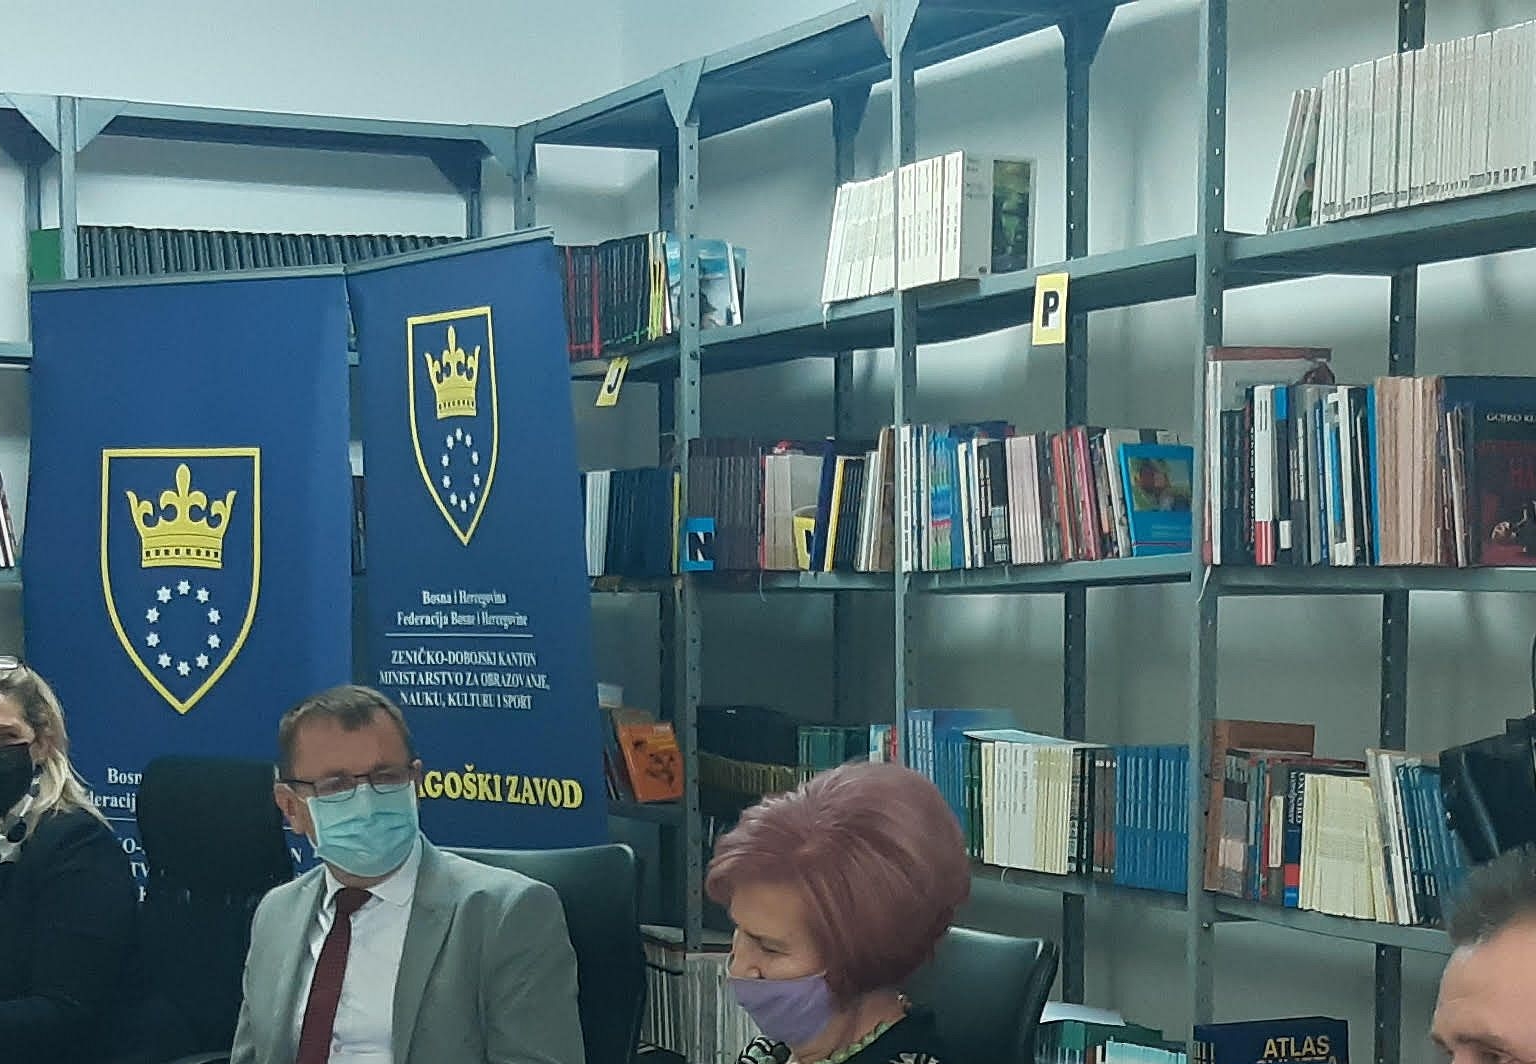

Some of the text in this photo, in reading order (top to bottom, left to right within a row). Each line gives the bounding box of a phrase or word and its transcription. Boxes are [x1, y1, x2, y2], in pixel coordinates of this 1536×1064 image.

[1041, 290, 1060, 328] P
[607, 367, 622, 394] J
[688, 532, 713, 561] N
[422, 590, 452, 605] Bosna
[397, 611, 449, 628] Federacija
[451, 612, 475, 626] Bosne
[391, 647, 537, 667] ZENIČKO-DOBOJSKI KANTON
[379, 671, 551, 690] MINISTARSTVO ZA OBRAZOVANJE,
[399, 691, 447, 708] NAUKU,
[448, 692, 494, 708] KULTURU
[503, 694, 533, 710] SPORT
[107, 767, 143, 785] Bosn
[418, 763, 583, 809] GOŠKI ZAVOD
[1263, 1034, 1331, 1059] ATLAS
